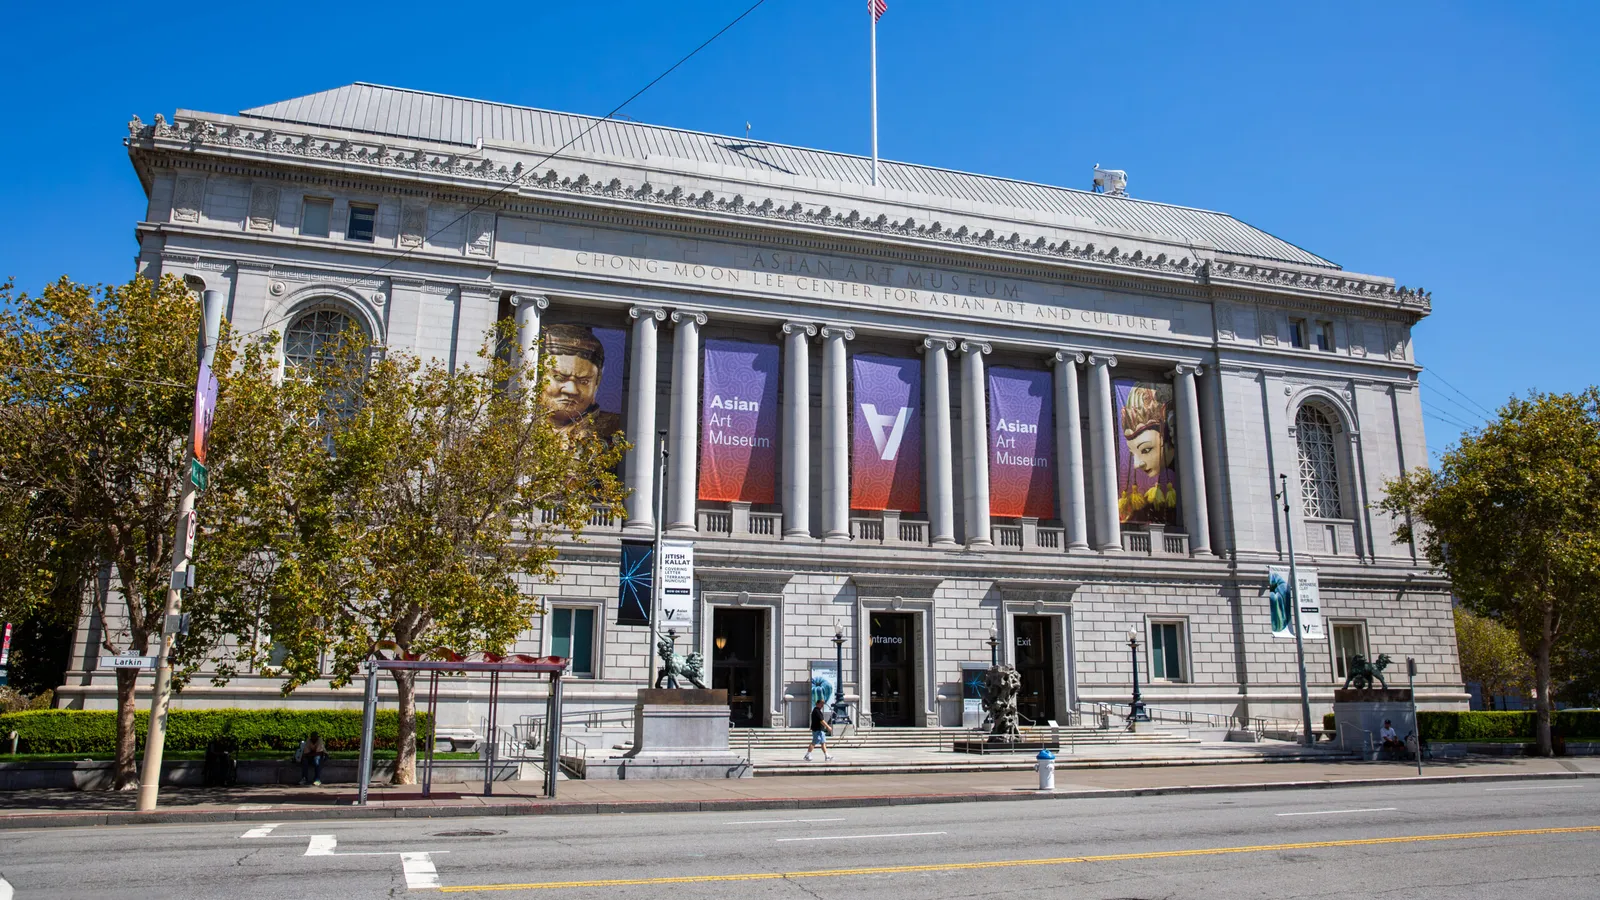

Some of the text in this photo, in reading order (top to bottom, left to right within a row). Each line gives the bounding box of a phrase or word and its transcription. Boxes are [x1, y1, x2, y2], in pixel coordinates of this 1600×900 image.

[753, 252, 1019, 298] ASIAN ART MUSEUM
[575, 252, 1158, 332] CHONG-MOON LEE CENTER FOR ASIAN ART AND CULTURE
[710, 394, 759, 412] Asian
[709, 412, 732, 428] Art
[995, 418, 1038, 434] Asian
[709, 429, 770, 448] Museum
[995, 434, 1016, 449] Art
[996, 450, 1048, 468] Museum
[871, 635, 903, 644] ntrance
[1016, 636, 1032, 646] Exit
[114, 658, 142, 666] Larkin
